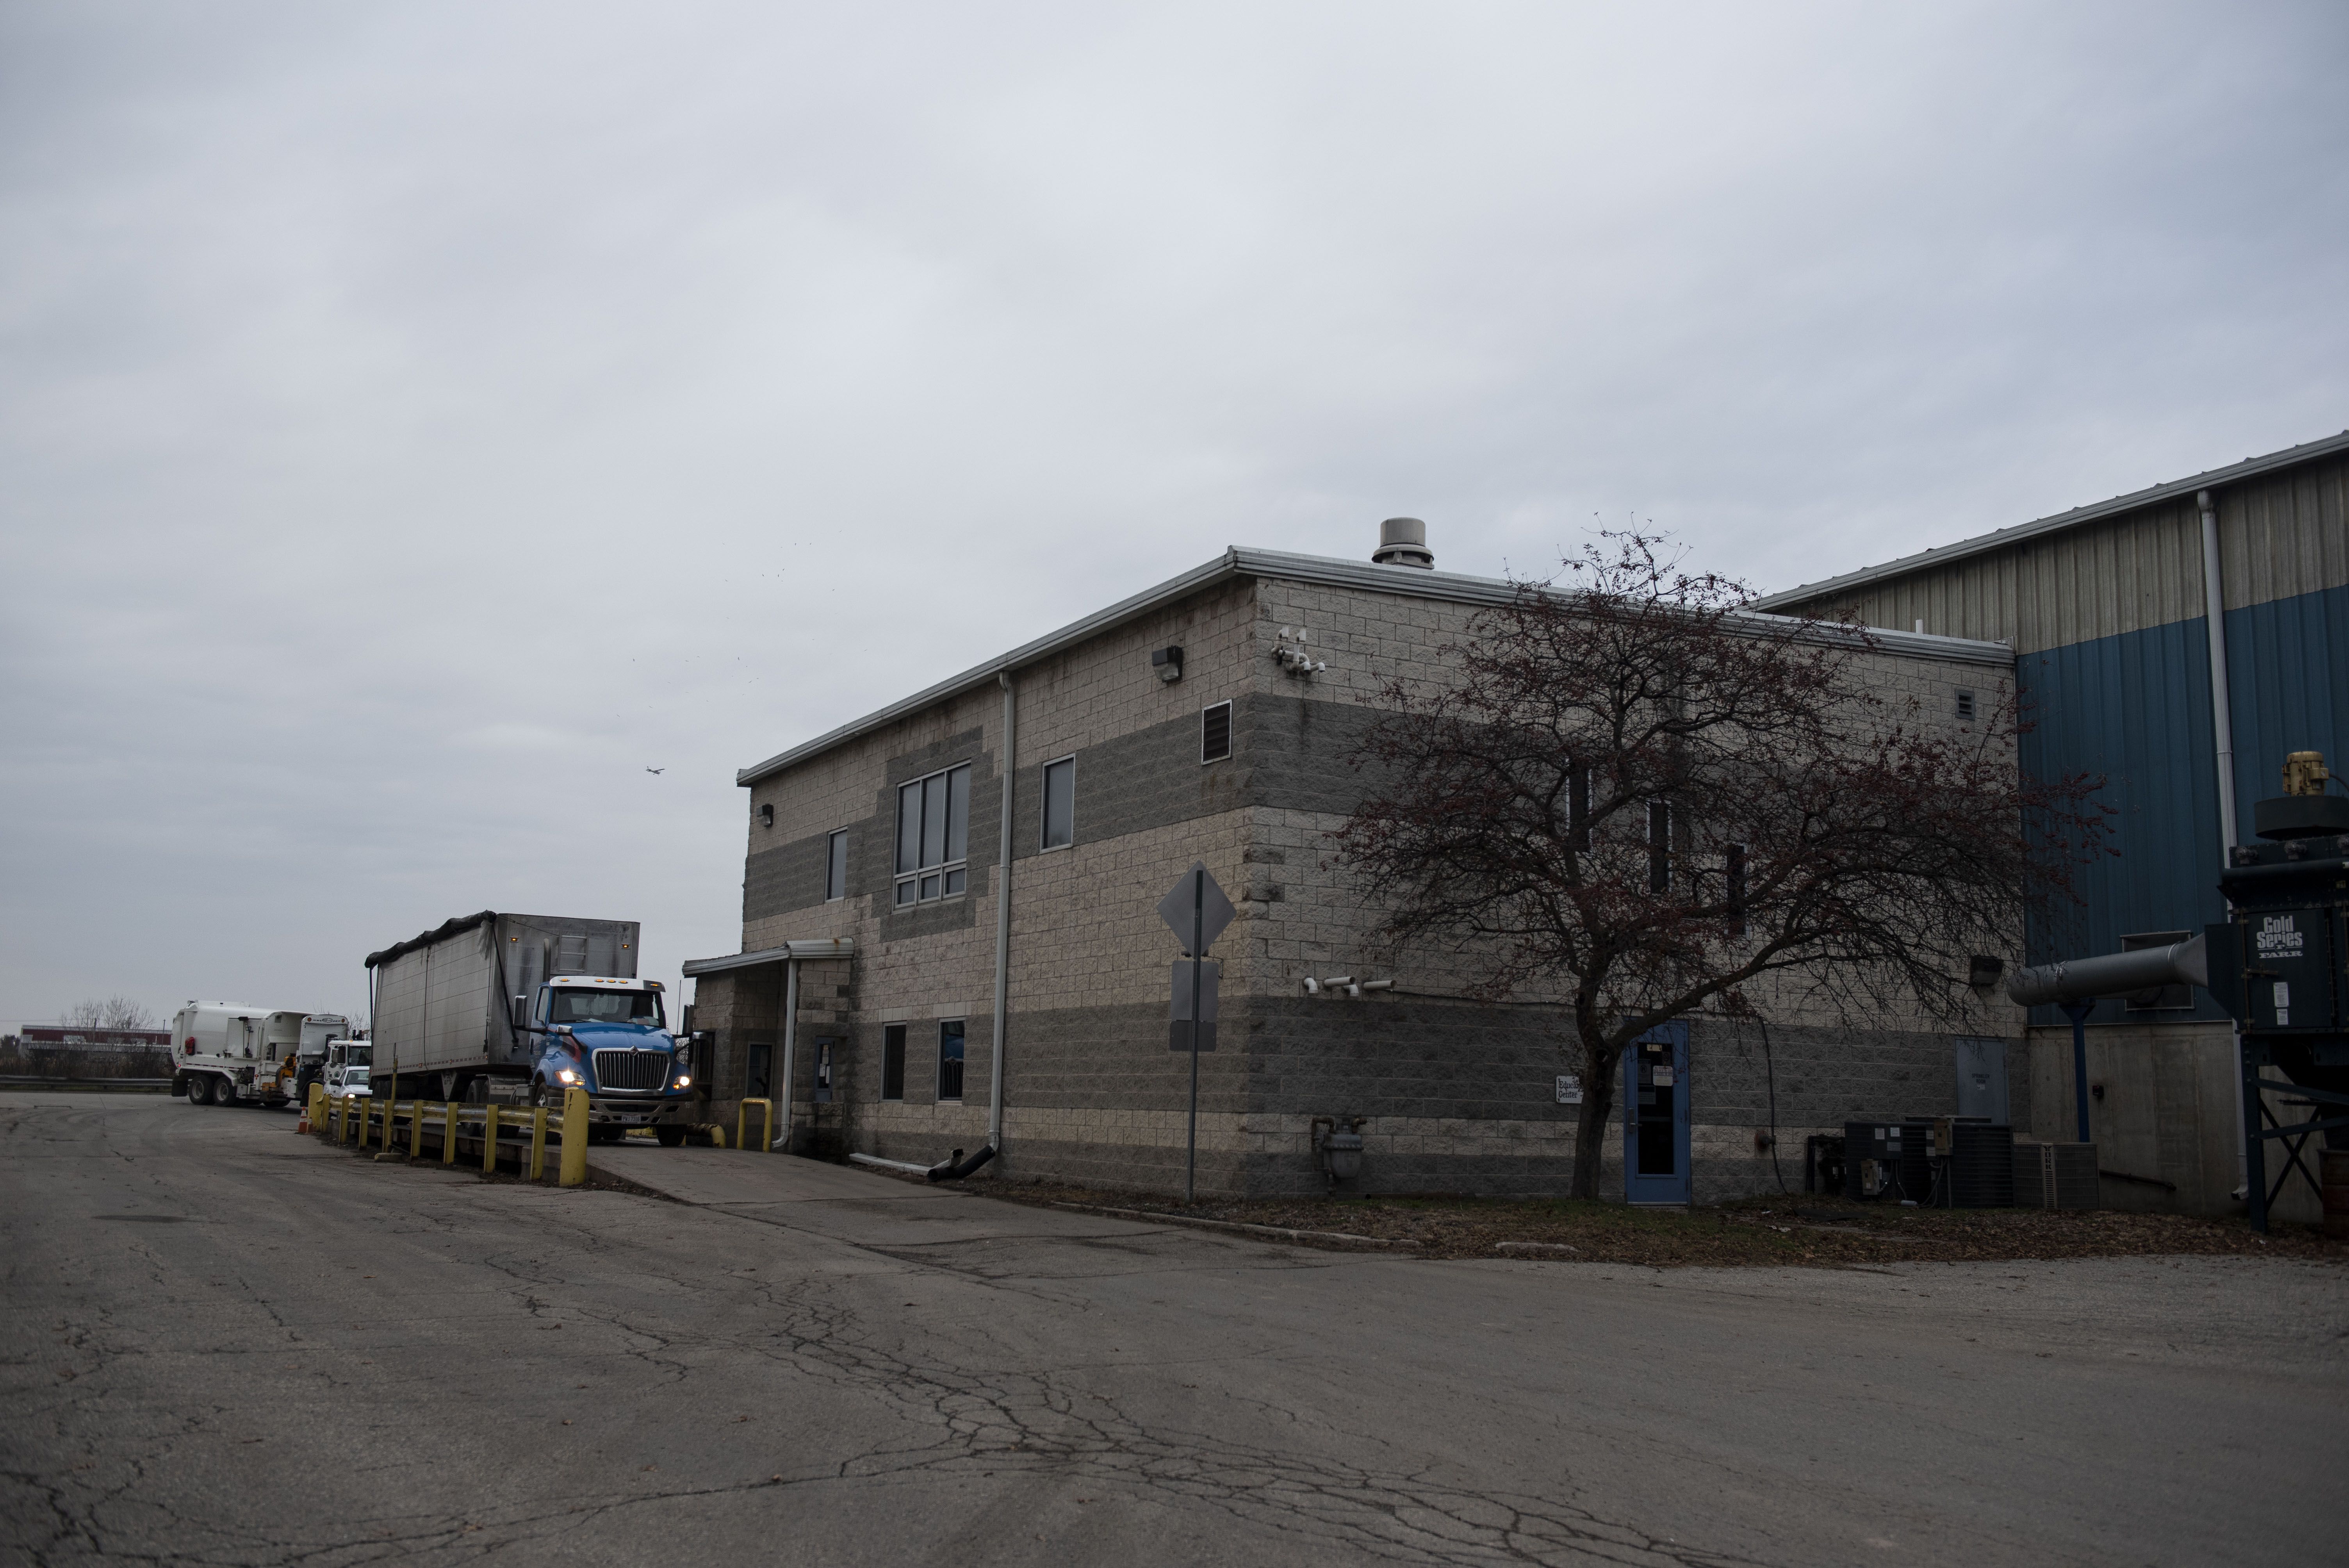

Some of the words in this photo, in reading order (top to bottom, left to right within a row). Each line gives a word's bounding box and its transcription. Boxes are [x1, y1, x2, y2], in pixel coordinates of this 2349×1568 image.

[2263, 916, 2294, 934] Gold
[2256, 932, 2303, 948] Series
[2043, 1146, 2052, 1169] YORK
